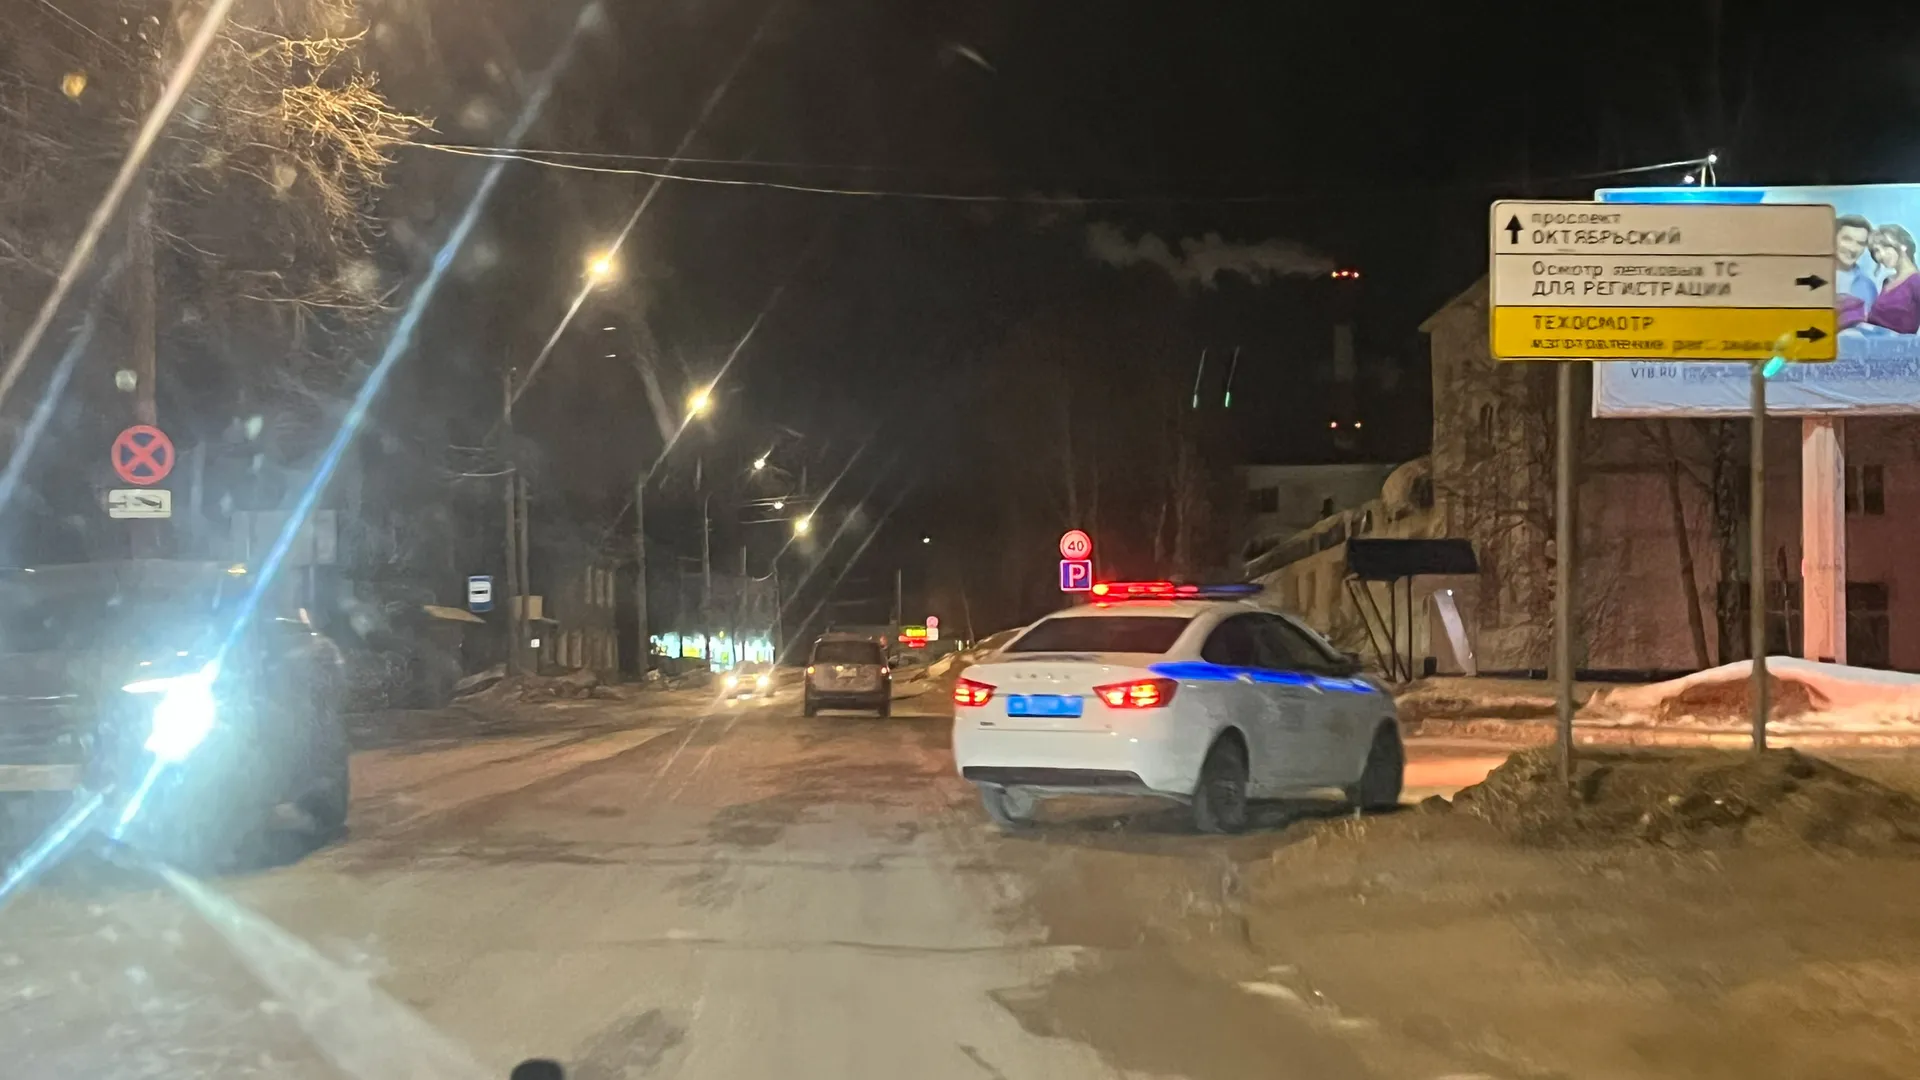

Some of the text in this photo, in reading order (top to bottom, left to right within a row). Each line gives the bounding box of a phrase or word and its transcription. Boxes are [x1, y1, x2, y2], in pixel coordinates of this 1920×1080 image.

[1531, 213, 1621, 227] проспект
[1531, 226, 1681, 245] ОКТЯБРЬСКИЙ
[1531, 260, 1603, 279] Осмотр
[1714, 261, 1740, 277] ТС
[1531, 280, 1732, 297] ДЛЯ РЕГИСТРАЦИИ
[1532, 315, 1654, 331] ТЕХОСМОТР
[1067, 540, 1085, 552] 40
